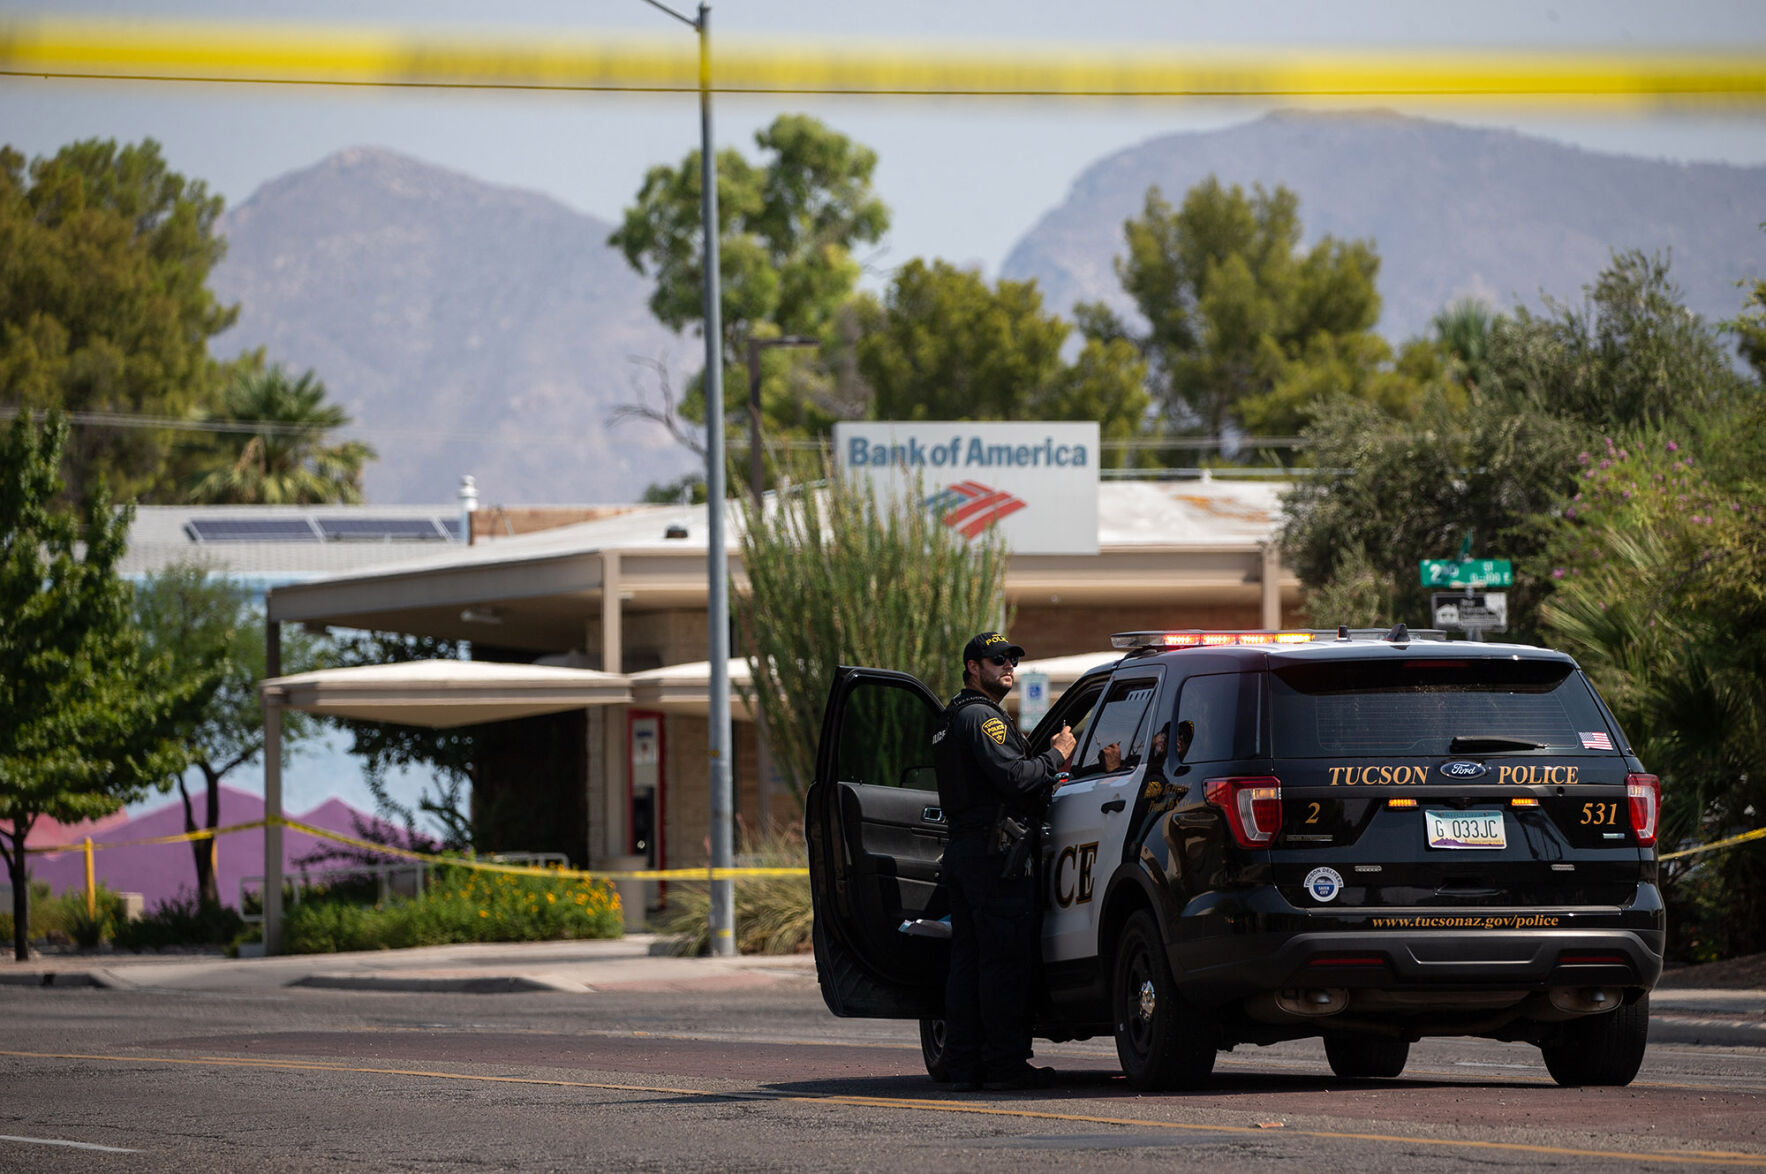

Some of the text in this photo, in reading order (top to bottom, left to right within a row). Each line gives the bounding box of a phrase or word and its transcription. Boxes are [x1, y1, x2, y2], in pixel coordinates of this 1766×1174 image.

[848, 437, 1088, 467] Bank of America
[1328, 765, 1579, 786] TUCSON POLICE
[1451, 763, 1476, 775] Ford
[1305, 802, 1321, 824] 2
[1580, 802, 1617, 825] 531
[1435, 819, 1498, 838] G 033JC
[1372, 914, 1560, 930] www.tucsonaz.gov/police
